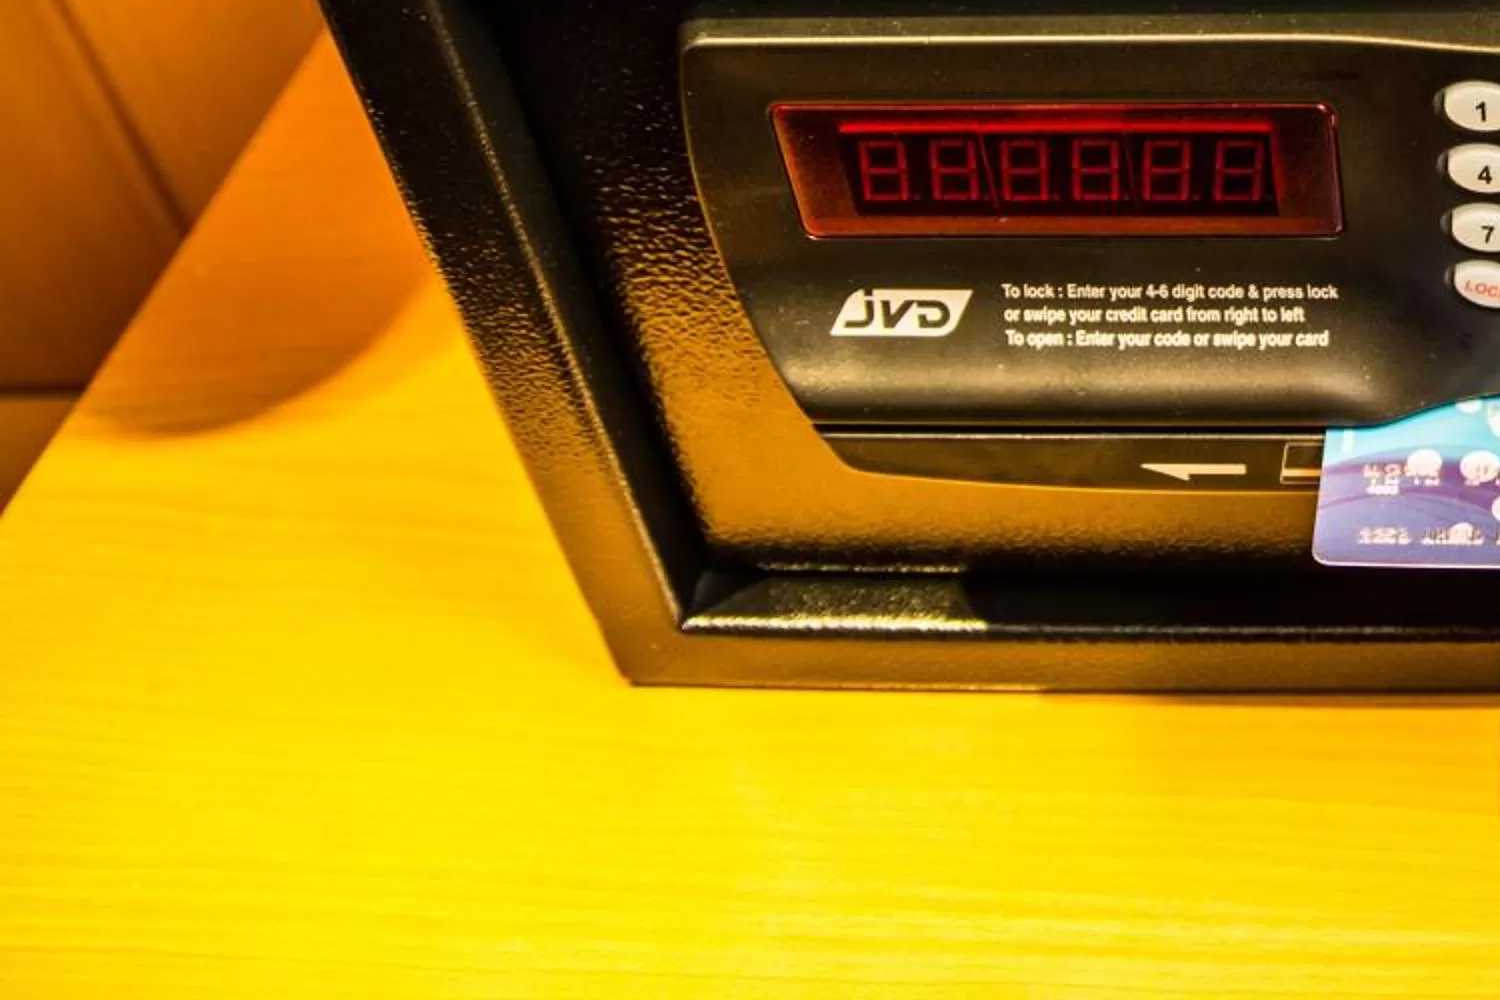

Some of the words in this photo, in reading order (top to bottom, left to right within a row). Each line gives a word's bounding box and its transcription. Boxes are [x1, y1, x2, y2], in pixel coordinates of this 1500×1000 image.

[1475, 101, 1488, 122] 1
[1477, 165, 1493, 184] 4
[1481, 225, 1496, 243] 7
[1001, 283, 1021, 299] To
[1023, 283, 1055, 299] lock
[1067, 283, 1105, 299] Enter
[1109, 285, 1143, 302] your
[1145, 283, 1169, 299] 4-6
[1171, 283, 1206, 302] digit
[1207, 284, 1245, 299] code
[1247, 284, 1259, 299] &
[1262, 286, 1304, 302] press
[1307, 283, 1339, 299] lock
[1004, 308, 1021, 322] or
[1023, 305, 1067, 326] swipe
[1069, 309, 1103, 326] your
[1105, 306, 1148, 322] credit
[1150, 306, 1184, 322] card
[1186, 306, 1222, 322] from
[1224, 306, 1259, 326] right
[1261, 307, 1278, 322] to
[1280, 306, 1306, 322] left
[1005, 330, 1025, 346] To
[1026, 334, 1065, 351] open
[1075, 330, 1116, 347] Enter
[1117, 333, 1153, 350] your
[1153, 331, 1191, 346] code
[1193, 333, 1211, 346] or
[1212, 331, 1257, 350] swipe
[1258, 333, 1294, 350] your
[1295, 330, 1330, 347] card
